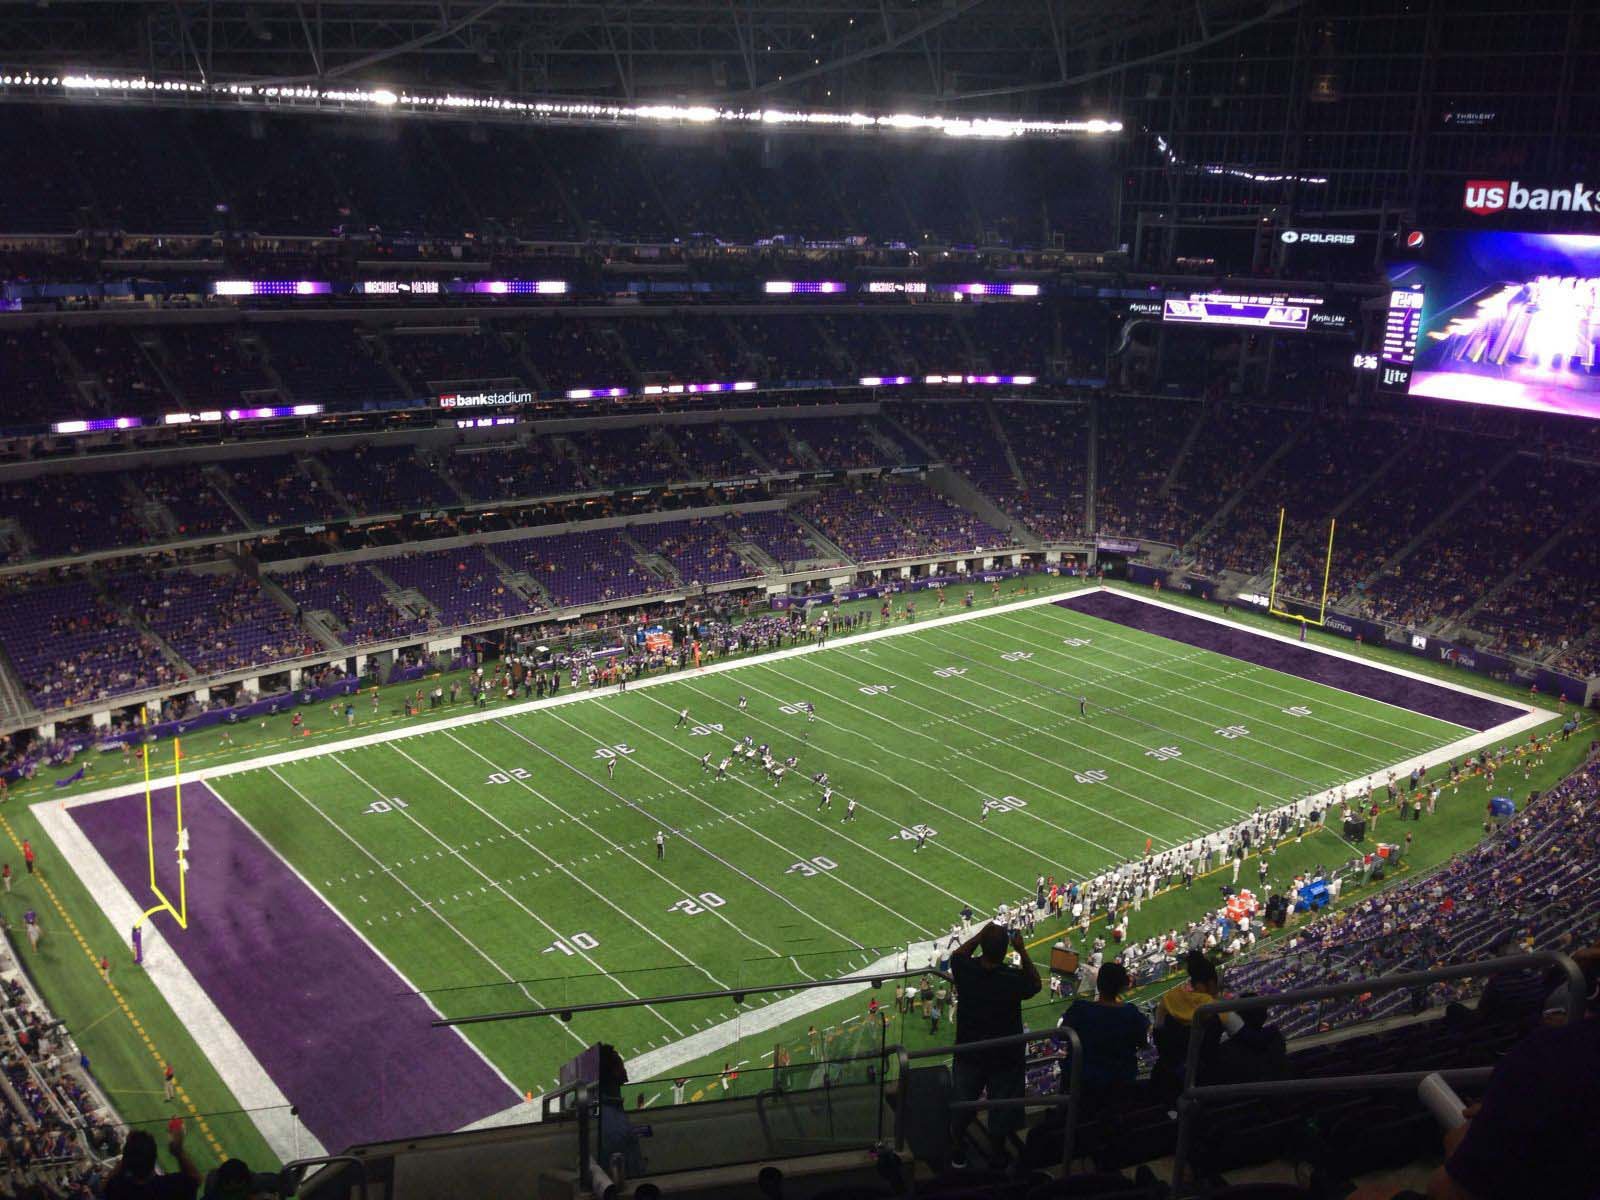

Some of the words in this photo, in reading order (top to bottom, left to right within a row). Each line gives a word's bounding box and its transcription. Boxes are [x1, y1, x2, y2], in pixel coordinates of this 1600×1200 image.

[1300, 233, 1356, 244] POLARIS
[1383, 369, 1408, 384] Lite
[1000, 651, 1034, 661] 20
[1282, 706, 1312, 717] 10
[1213, 725, 1250, 738] 20
[595, 743, 636, 758] 30
[1143, 746, 1182, 760] 30
[488, 768, 532, 784] 20
[1074, 769, 1109, 783] 40
[369, 797, 409, 813] 10
[987, 796, 1028, 812] 50
[790, 856, 839, 877] 30
[675, 892, 727, 915] 20
[552, 932, 600, 955] 10
